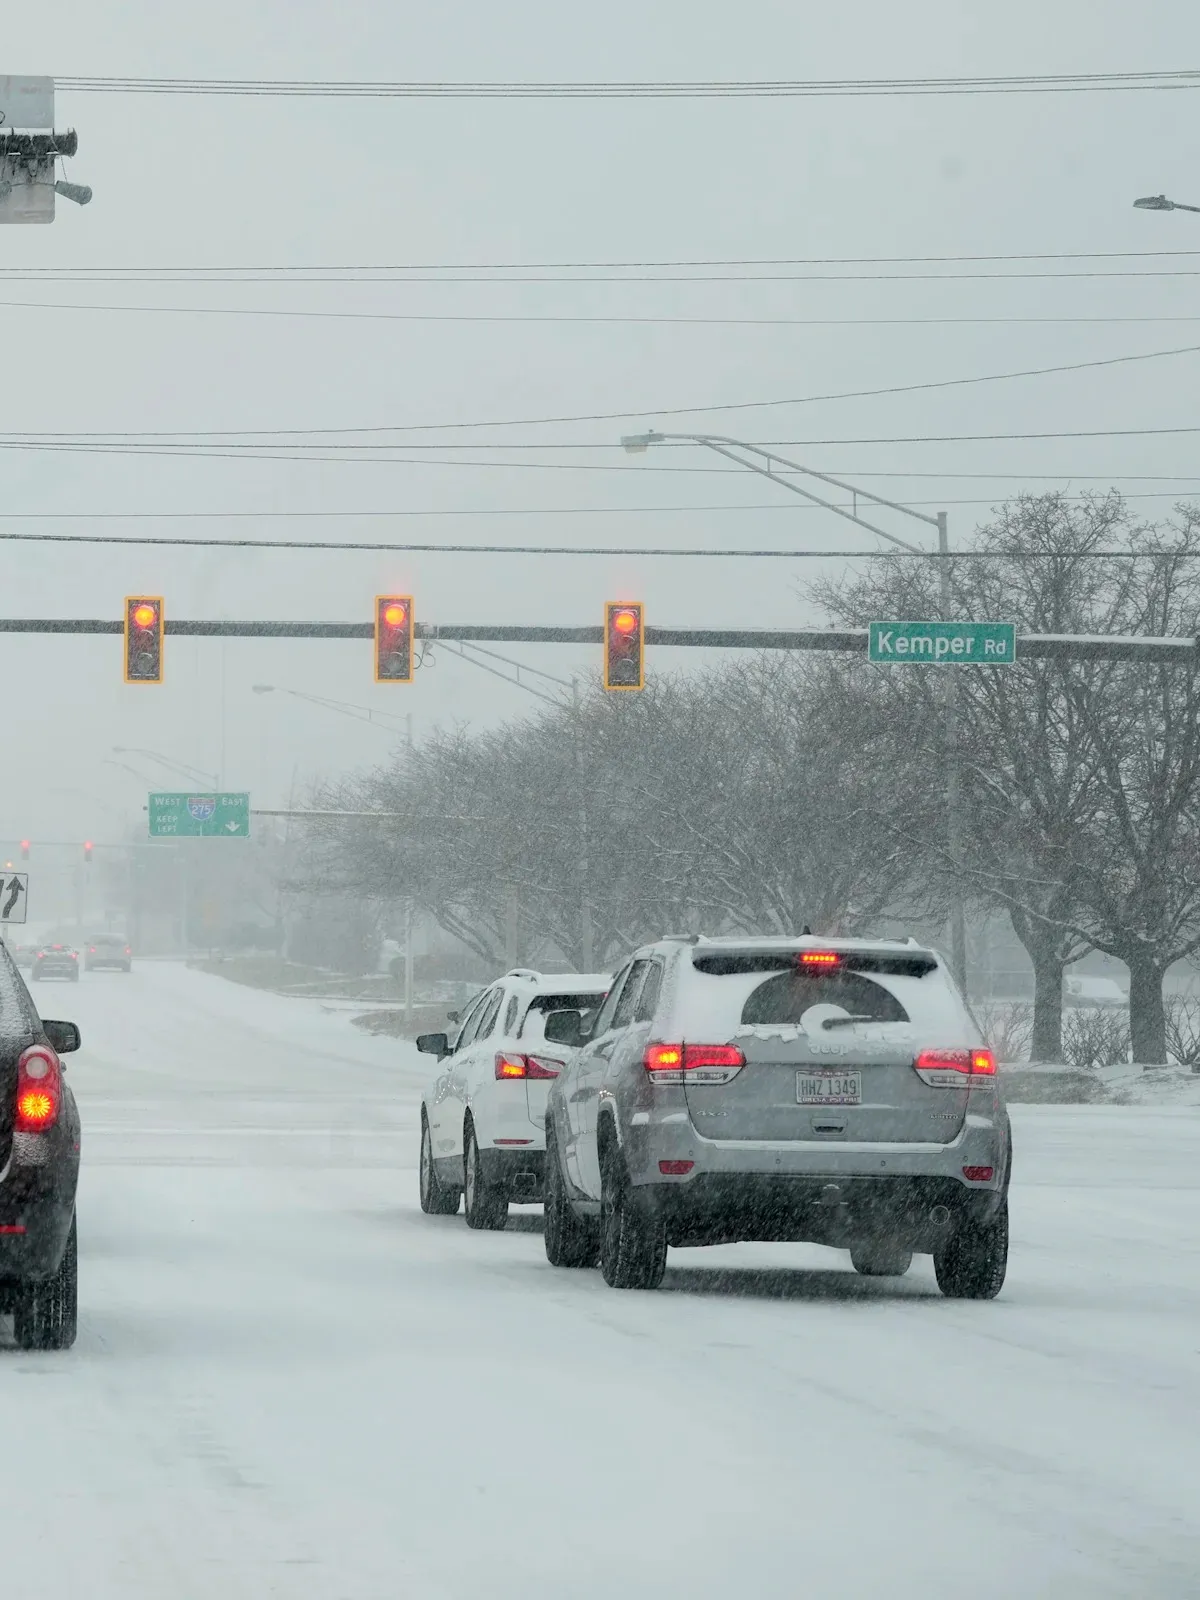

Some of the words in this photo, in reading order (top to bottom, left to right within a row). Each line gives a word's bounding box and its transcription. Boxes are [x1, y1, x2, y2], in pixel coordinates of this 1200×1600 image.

[878, 631, 975, 659] Kemper
[984, 639, 1006, 655] Rd
[191, 804, 211, 816] 275
[156, 815, 178, 823] KEEP
[801, 1079, 823, 1096] HHZ
[827, 1079, 857, 1096] 1349
